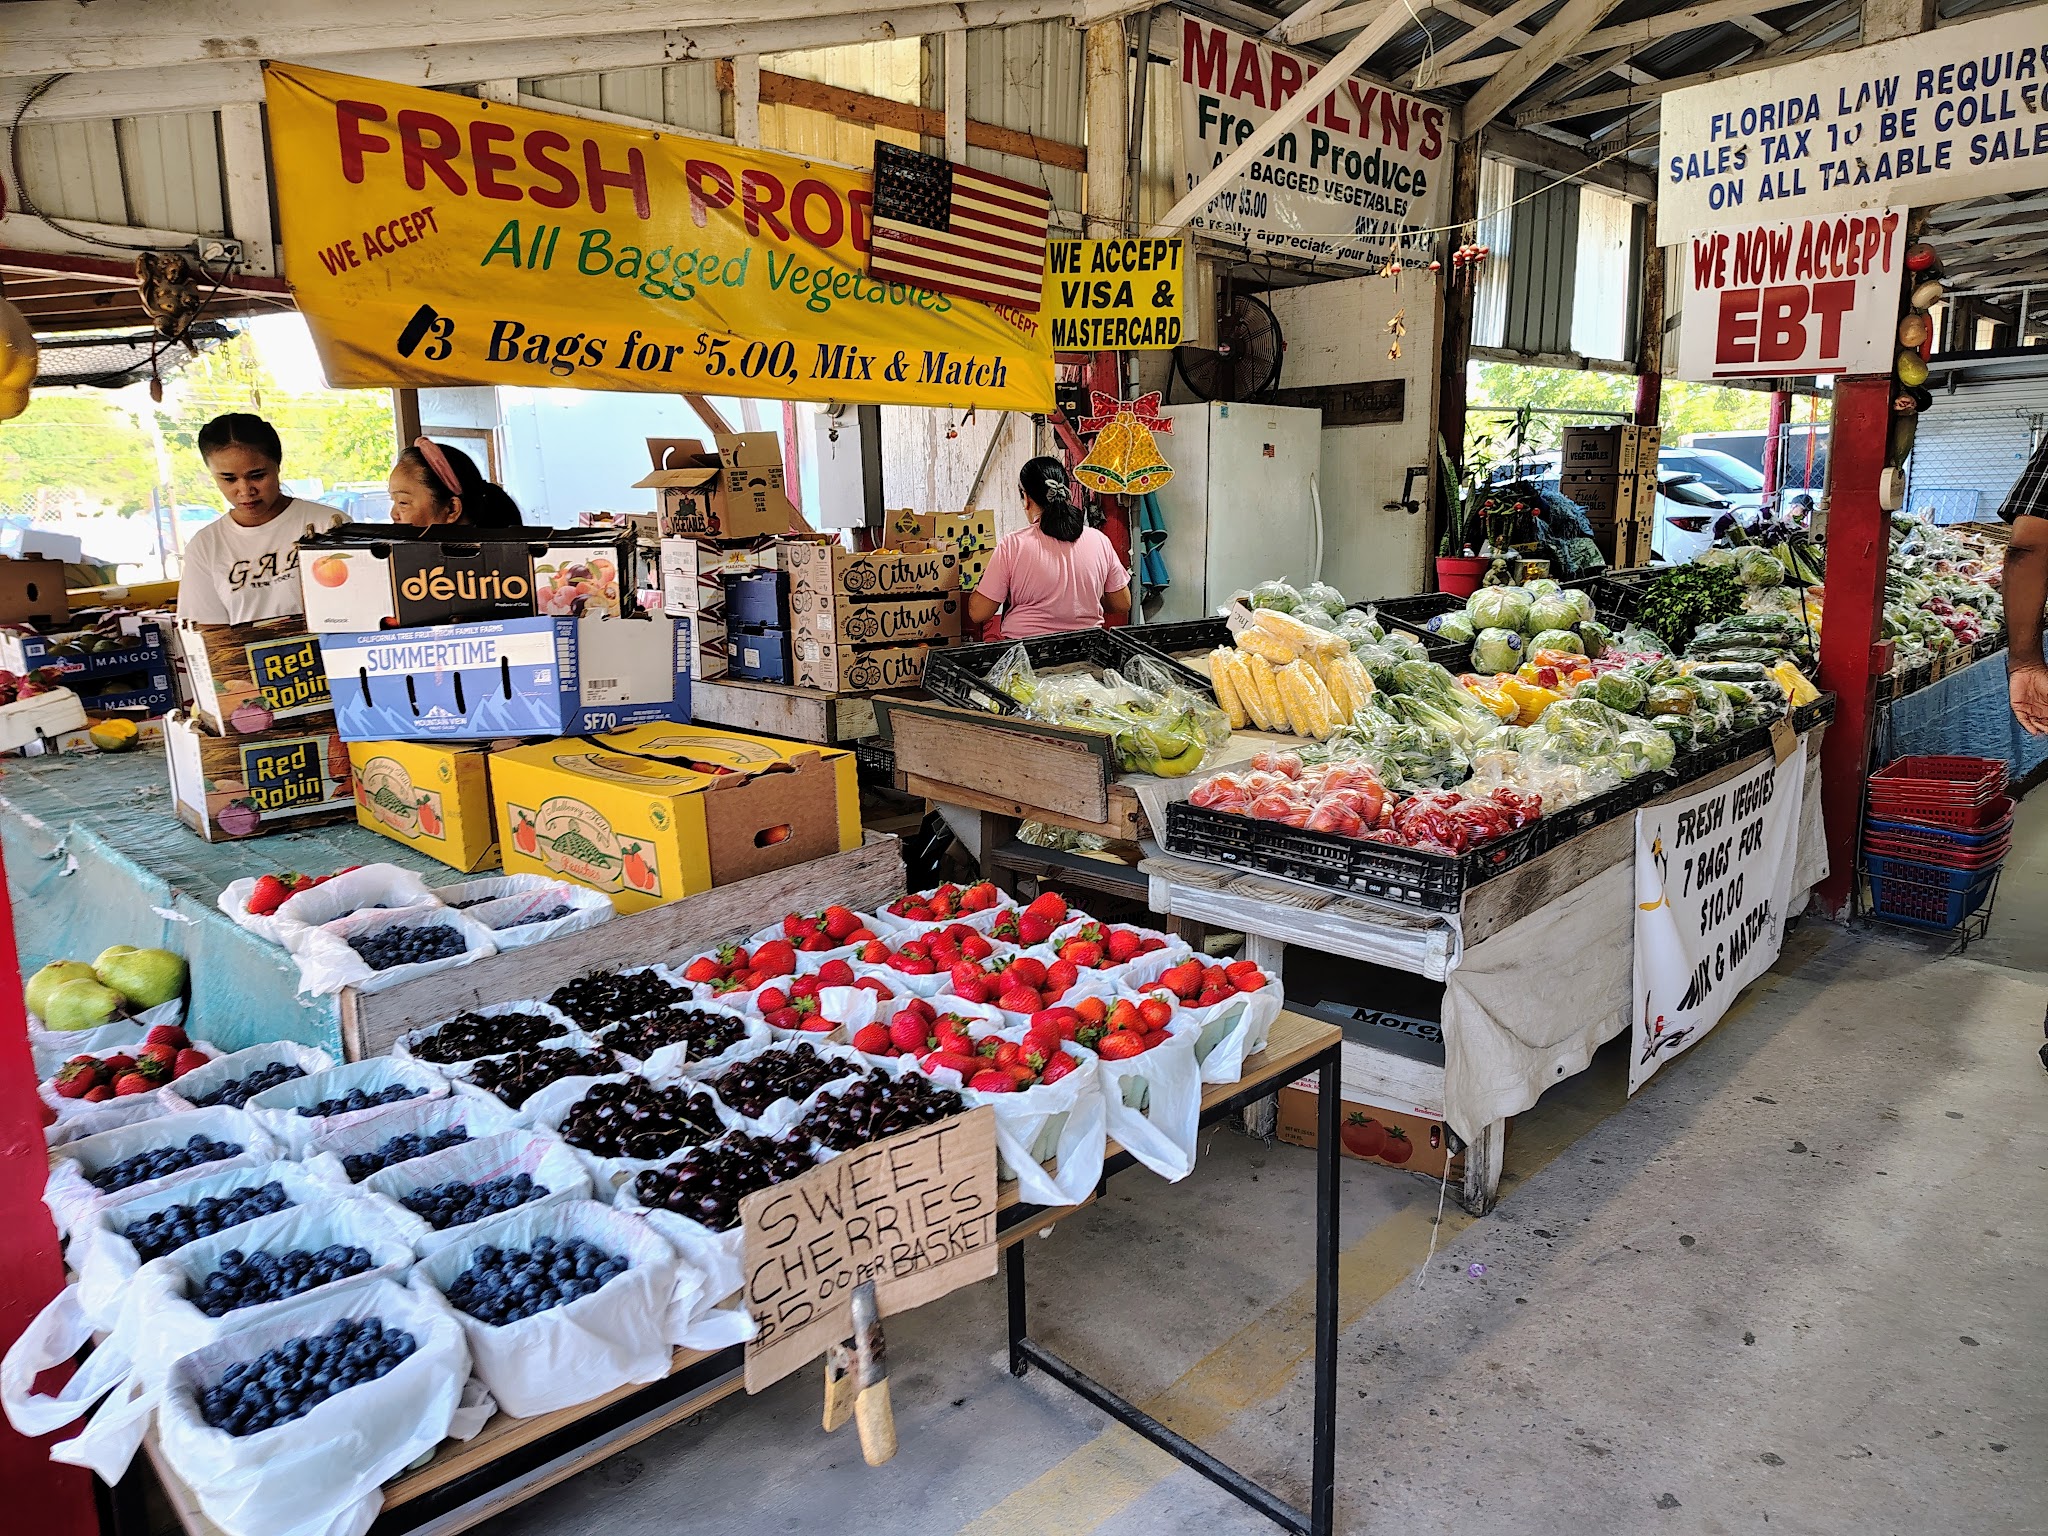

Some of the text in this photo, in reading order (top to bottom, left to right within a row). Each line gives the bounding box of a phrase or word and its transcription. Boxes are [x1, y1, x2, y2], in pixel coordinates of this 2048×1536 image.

[1710, 94, 1820, 143] FLORIDA
[1838, 75, 1900, 116] LAW
[335, 99, 652, 221] FRESH
[1199, 94, 1428, 197] Freh Produce
[1670, 143, 1748, 183] SALES
[1761, 129, 1812, 165] TAX
[1880, 107, 1917, 143] BE
[1708, 179, 1743, 211] ON
[1758, 168, 1807, 202] ALL
[1819, 139, 1953, 191] TAXABLE
[1250, 162, 1320, 195] BAGGED
[1324, 179, 1409, 217] VEGETABLES
[317, 206, 439, 277] WE ACCEPT
[480, 219, 953, 314] All Bagged Vegetables
[1050, 239, 1183, 274] WE ACCEPT
[1256, 229, 1333, 255] appreciate
[1336, 246, 1366, 260] your
[1694, 211, 1899, 291] WE NOW ACCEPT
[993, 302, 1039, 339] ACCEPT
[1061, 279, 1176, 309] VISA &
[1715, 279, 1857, 365] EBT
[484, 320, 608, 377] Bags
[614, 330, 685, 373] for
[693, 332, 799, 386] $5.00,
[808, 343, 877, 381] Mix
[883, 350, 911, 383] &
[915, 350, 1007, 388] Match
[1051, 316, 1181, 347] MASTERCARD
[878, 556, 940, 592] Citrus
[357, 633, 398, 644] CALIFORNIA
[397, 632, 414, 641] TREE
[479, 624, 504, 634] FARMS
[880, 605, 942, 638] Citrus
[96, 650, 159, 667] MANGOS
[264, 642, 315, 681] Red
[367, 639, 497, 672] SUMMERTIME
[104, 693, 167, 711] MANGOS
[261, 671, 331, 709] Robin
[583, 712, 617, 730] SF70
[250, 774, 321, 810] Robin
[256, 745, 306, 782] Red
[1675, 765, 1776, 849] FRESH VEGGIES
[1682, 816, 1764, 898] 7 BAGS FOR
[1700, 871, 1744, 937] $10.00
[1676, 899, 1770, 1012] MIX & MATCH
[757, 1122, 961, 1249] SWEET
[750, 1175, 982, 1305] CHERRIES
[749, 1208, 998, 1348] $5.00 PER BASKET
